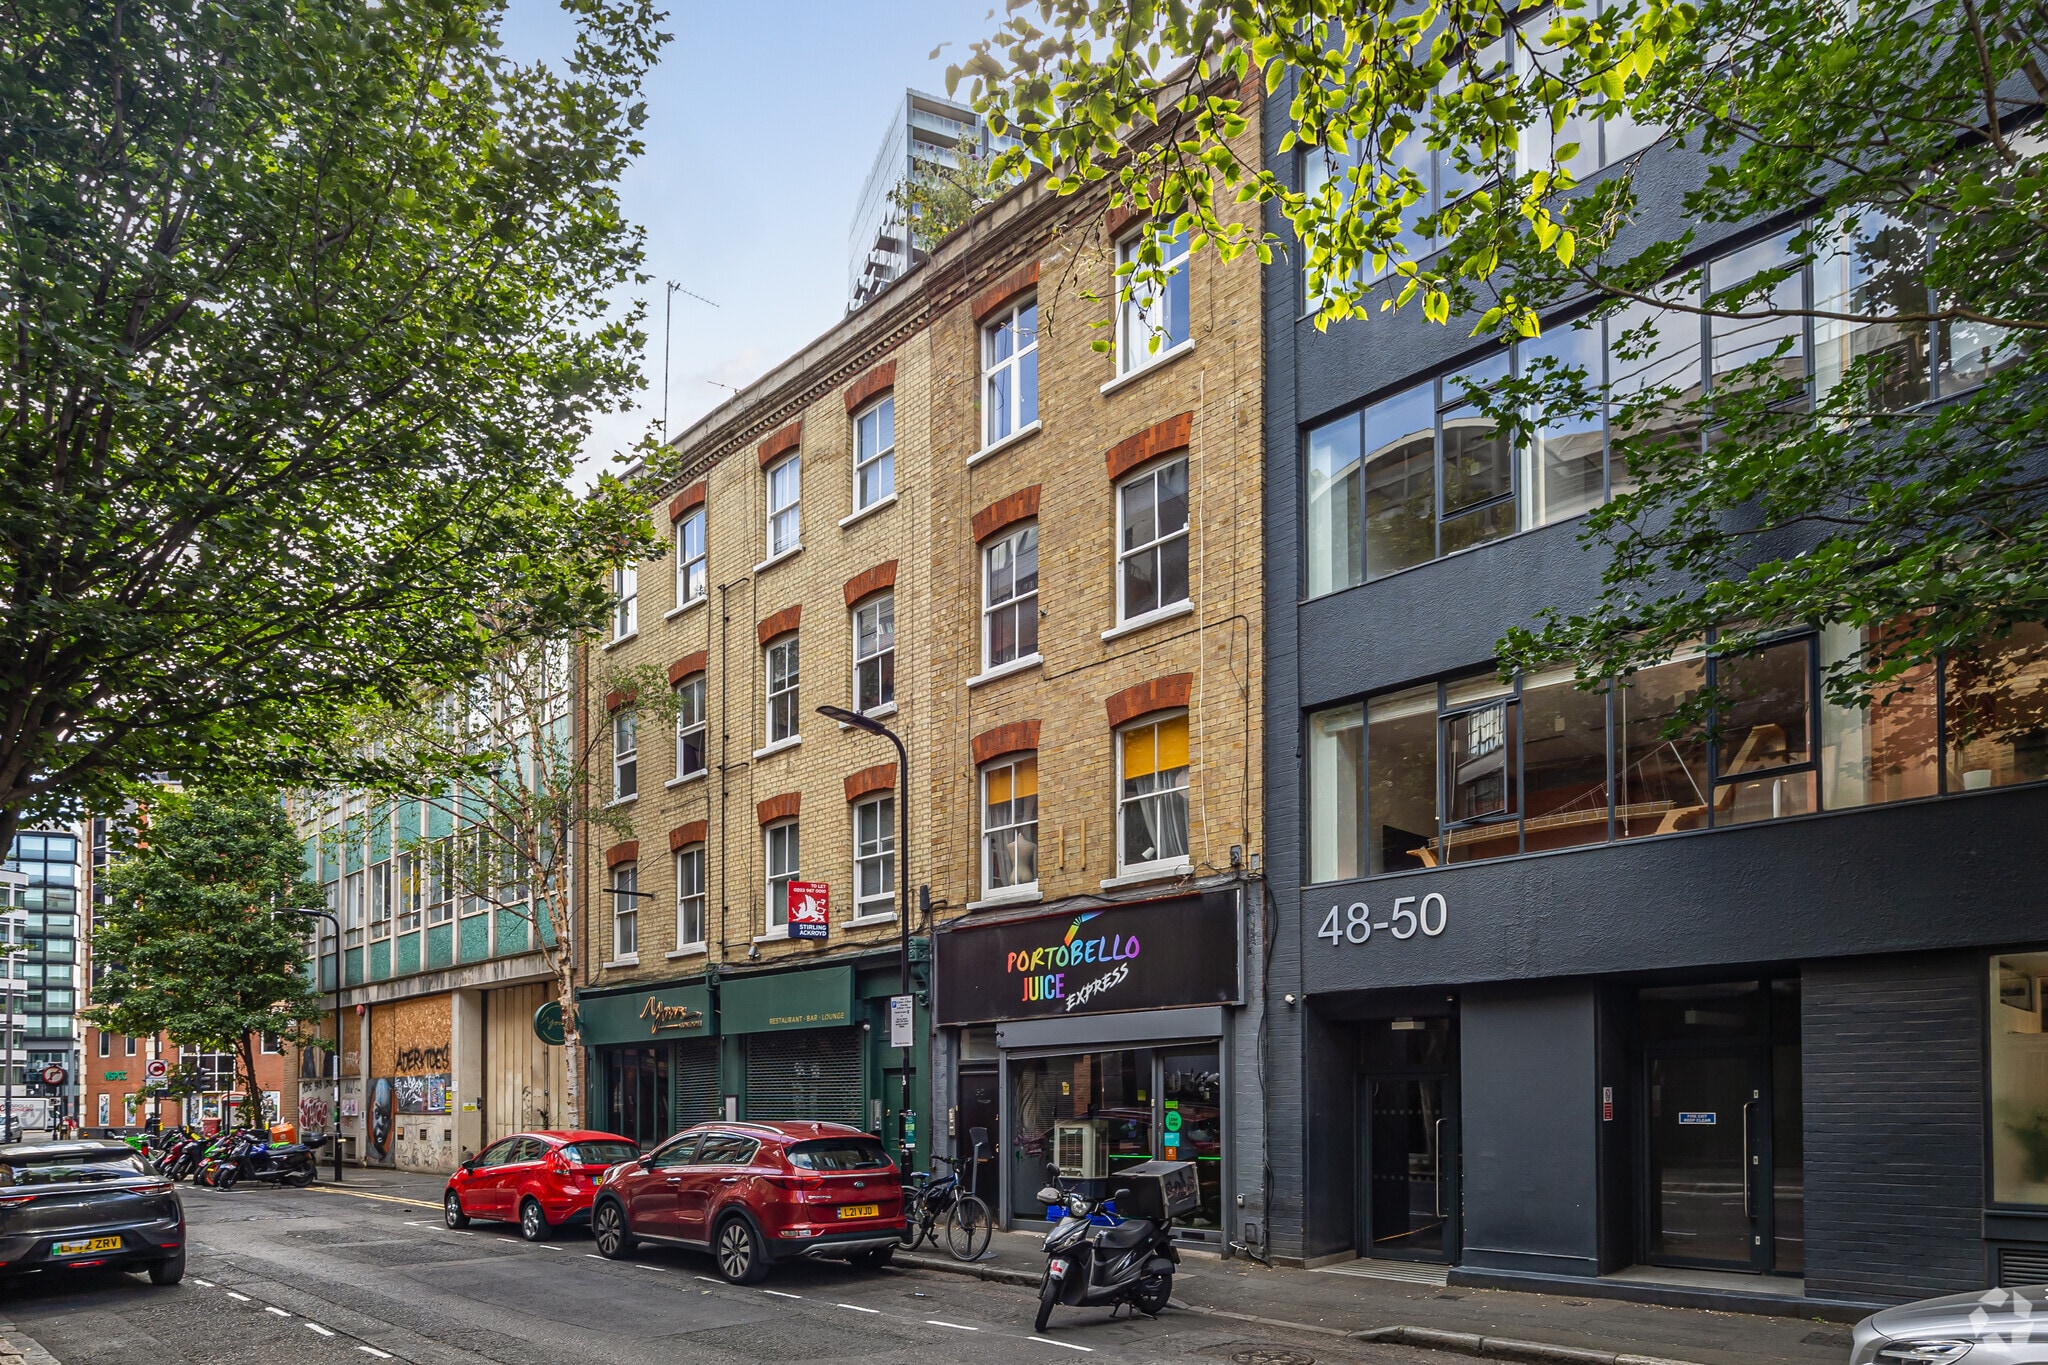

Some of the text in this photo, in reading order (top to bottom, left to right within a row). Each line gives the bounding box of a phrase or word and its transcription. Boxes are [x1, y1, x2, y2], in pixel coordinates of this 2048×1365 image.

[1318, 893, 1447, 946] 48-50
[1007, 934, 1140, 974] PORTOBELLO
[1022, 973, 1065, 1002] JUICE
[1065, 962, 1129, 1012] EXPRESS
[769, 1016, 803, 1025] RESTAURANT
[821, 1012, 845, 1020] LOUNGE
[104, 1070, 127, 1081] NSPCC
[95, 1238, 117, 1249] ZRV
[1052, 1261, 1062, 1273] L
